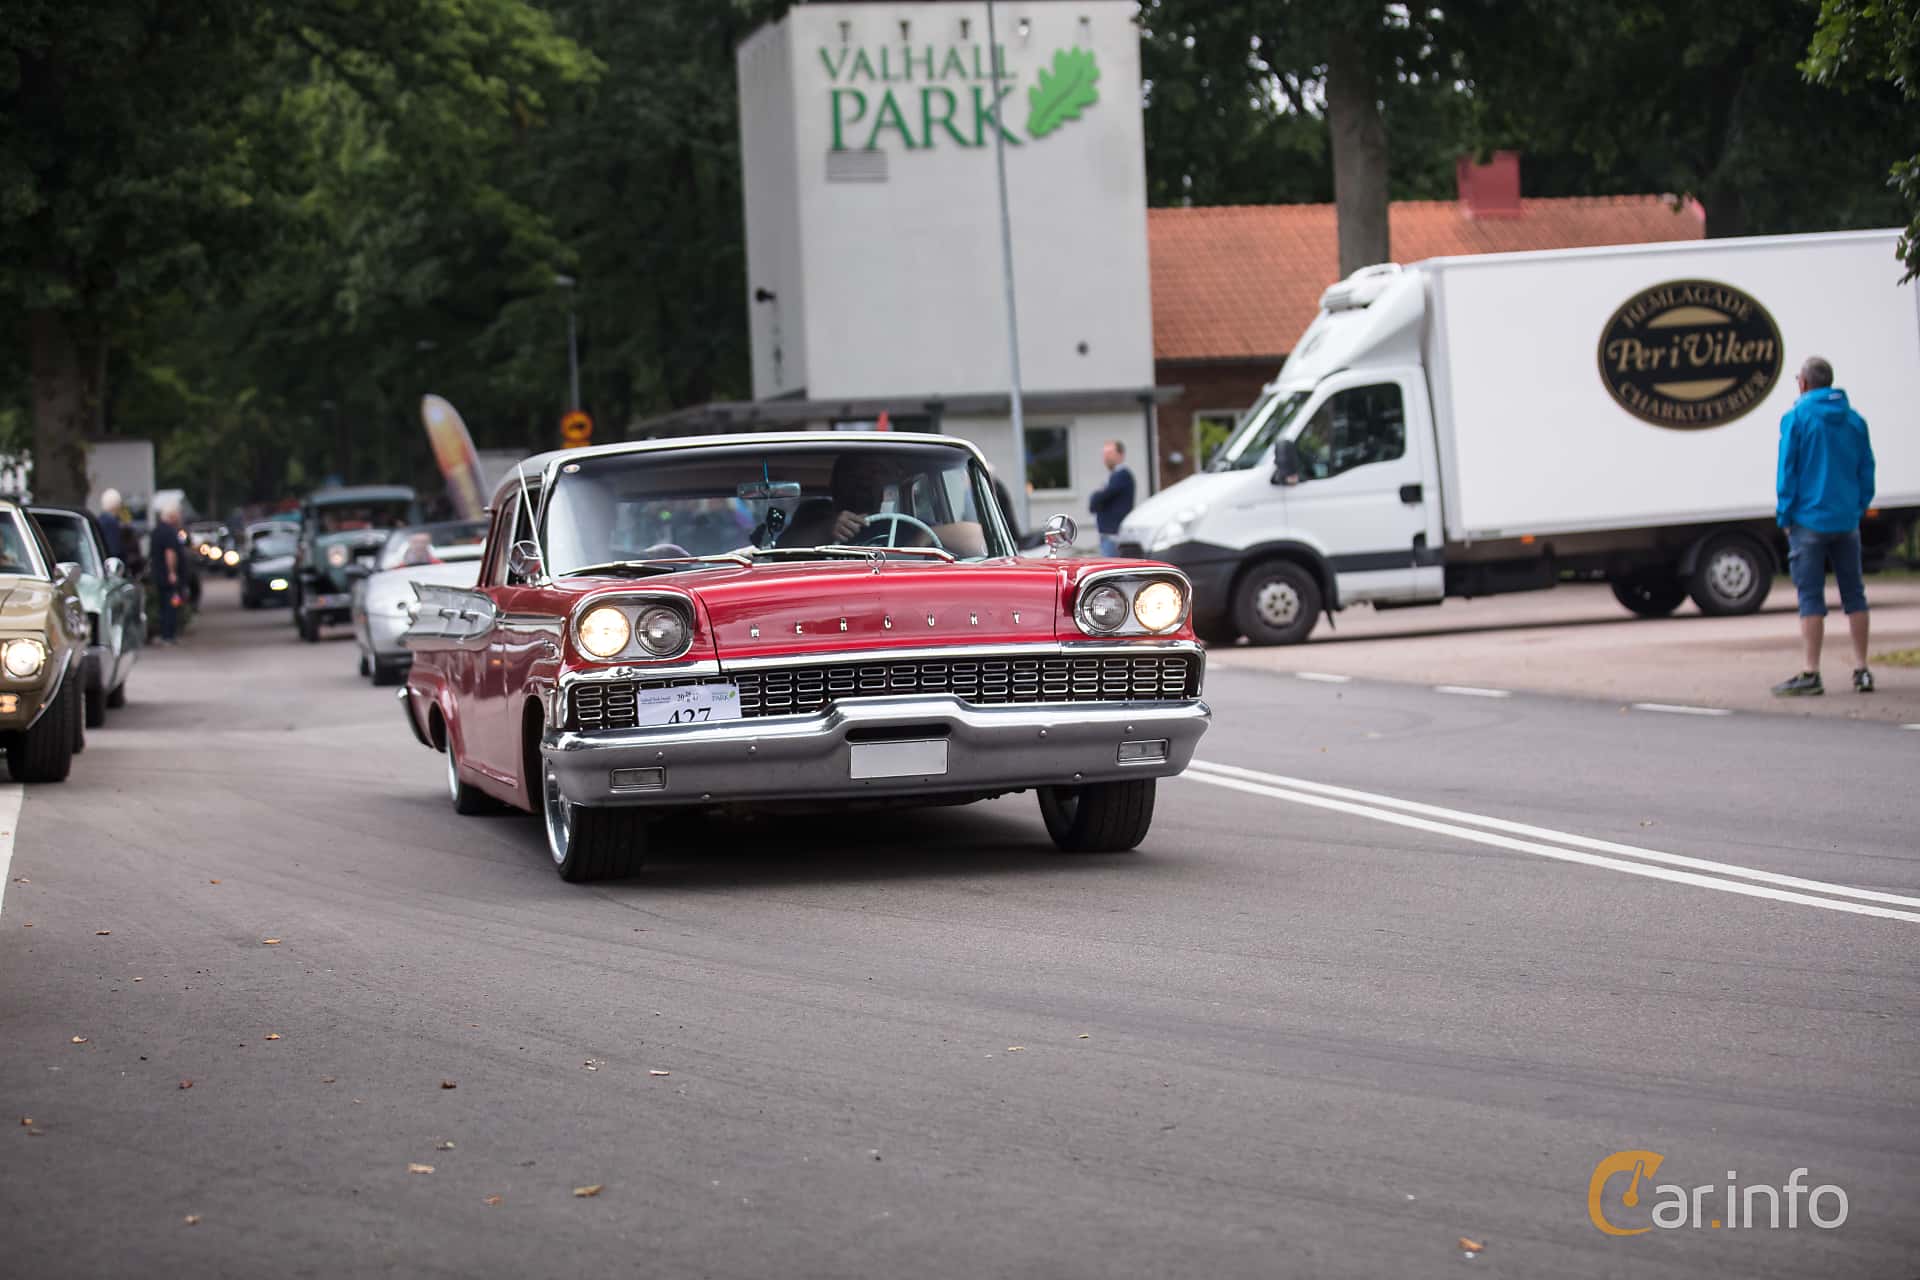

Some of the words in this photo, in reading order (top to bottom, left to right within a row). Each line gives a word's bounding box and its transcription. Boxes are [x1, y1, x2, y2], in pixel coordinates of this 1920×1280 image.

[820, 45, 1017, 81] VALHALL
[830, 85, 1023, 150] PARK
[1607, 337, 1666, 373] Per
[1669, 335, 1681, 369] i
[1683, 331, 1774, 367] Viken
[751, 611, 1020, 640] MERCURY
[668, 707, 711, 724] 427
